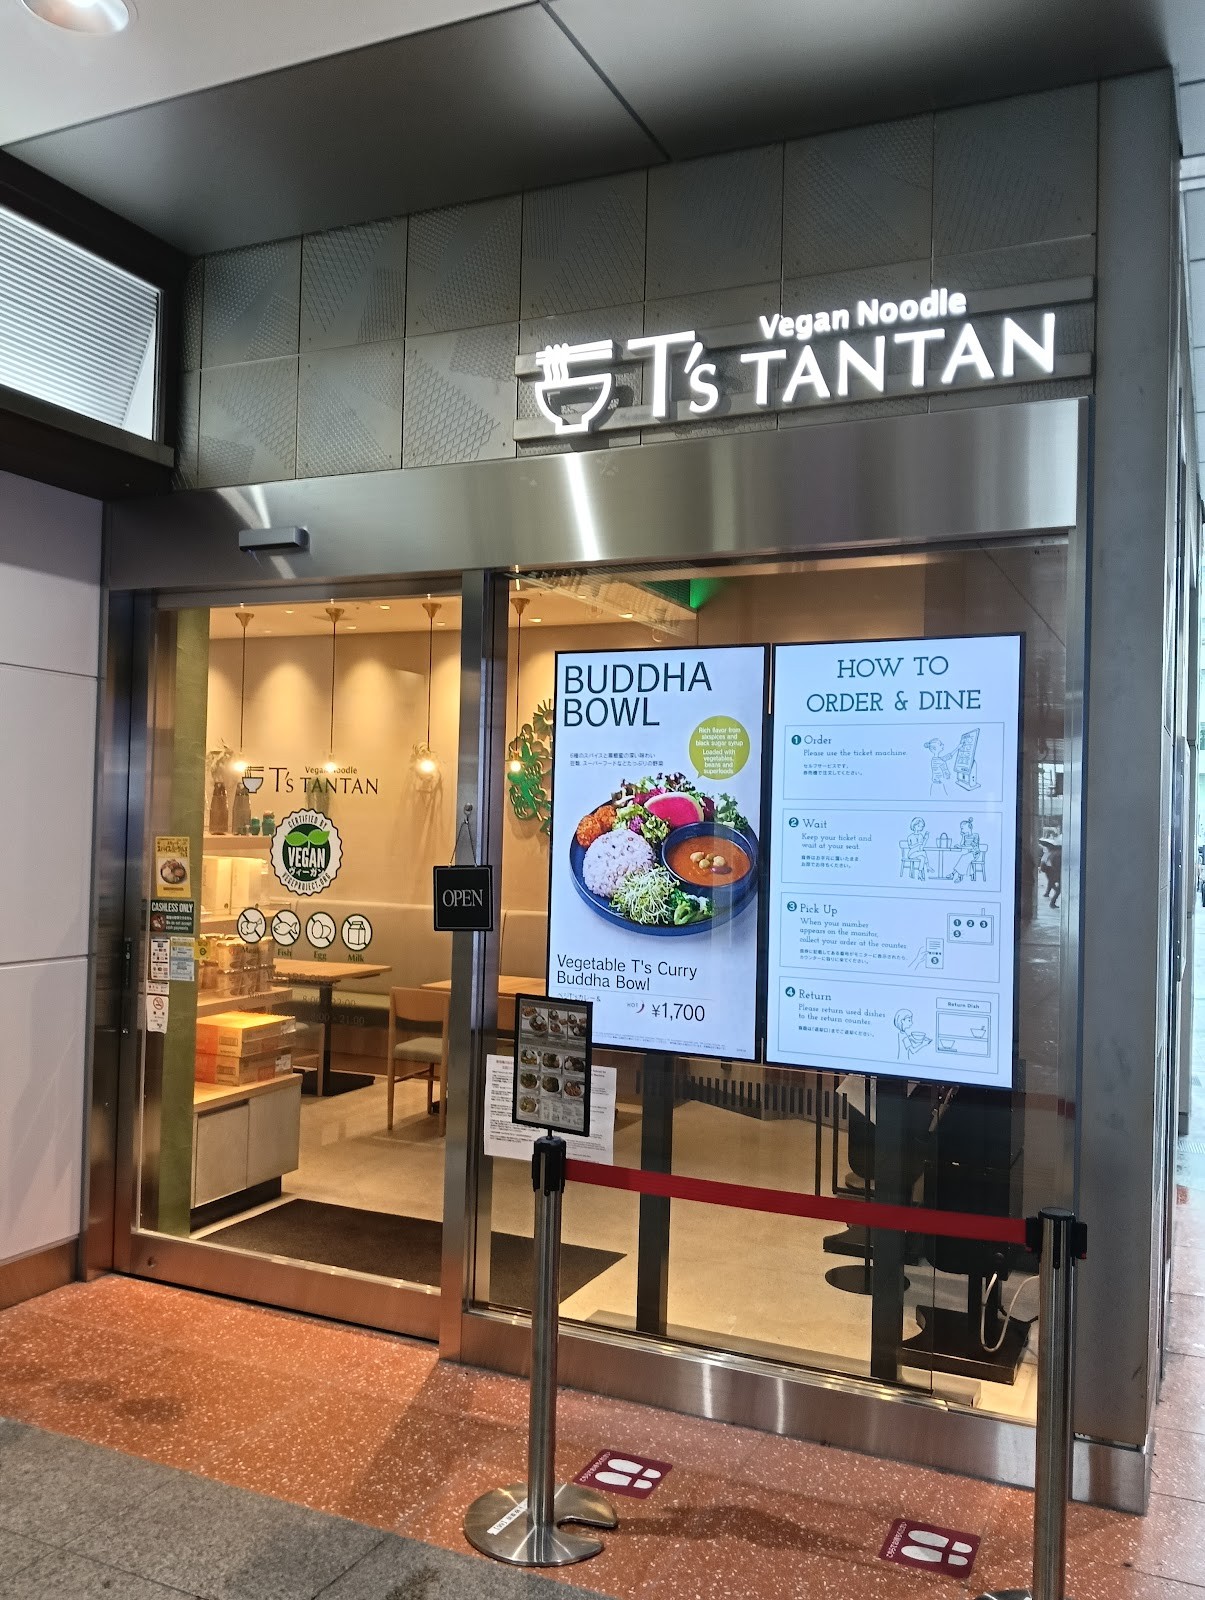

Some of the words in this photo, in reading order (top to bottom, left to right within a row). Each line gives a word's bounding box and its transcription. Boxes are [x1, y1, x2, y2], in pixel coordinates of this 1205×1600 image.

[759, 309, 850, 341] Vegan
[857, 289, 967, 326] Noodle
[627, 330, 718, 418] T's
[741, 312, 1056, 405] TANTAN
[837, 658, 904, 678] HOW
[914, 656, 949, 676] TO
[565, 662, 712, 694] BUDDHA
[806, 692, 884, 712] ORDER
[894, 690, 908, 711] &
[919, 690, 981, 710] DINE
[564, 697, 660, 727] BOWL
[804, 735, 832, 745] Order
[269, 767, 294, 793] T's
[300, 777, 378, 794] TANTAN
[288, 814, 318, 828] CERTIFIED
[320, 820, 327, 829] BY
[803, 818, 827, 829] Wait
[802, 833, 818, 842] Keep
[820, 835, 836, 843] your
[288, 846, 326, 868] VEGAN
[288, 866, 326, 877] ヴィーガン
[282, 872, 331, 891] VEGEPROJECT.ORG
[152, 902, 178, 912] CASHLESS
[179, 903, 193, 913] ONLY
[442, 889, 483, 908] OPEN
[800, 903, 819, 914] Pick
[823, 904, 838, 916] Up
[800, 918, 822, 926] When
[824, 920, 840, 929] your
[820, 939, 836, 947] your
[868, 940, 879, 948] the
[277, 948, 292, 958] Fish
[314, 951, 327, 961] Egg
[348, 953, 364, 962] Milk
[557, 954, 626, 974] Vegetable
[632, 960, 652, 974] T's
[658, 961, 698, 980] Curry
[557, 971, 610, 988] Buddha
[616, 976, 650, 991] Bowl
[799, 989, 832, 1001] Return
[652, 1002, 705, 1022] ¥1,700
[798, 1004, 818, 1012] Please
[821, 1006, 844, 1015] return
[846, 1008, 862, 1016] used
[864, 1009, 886, 1018] dishes
